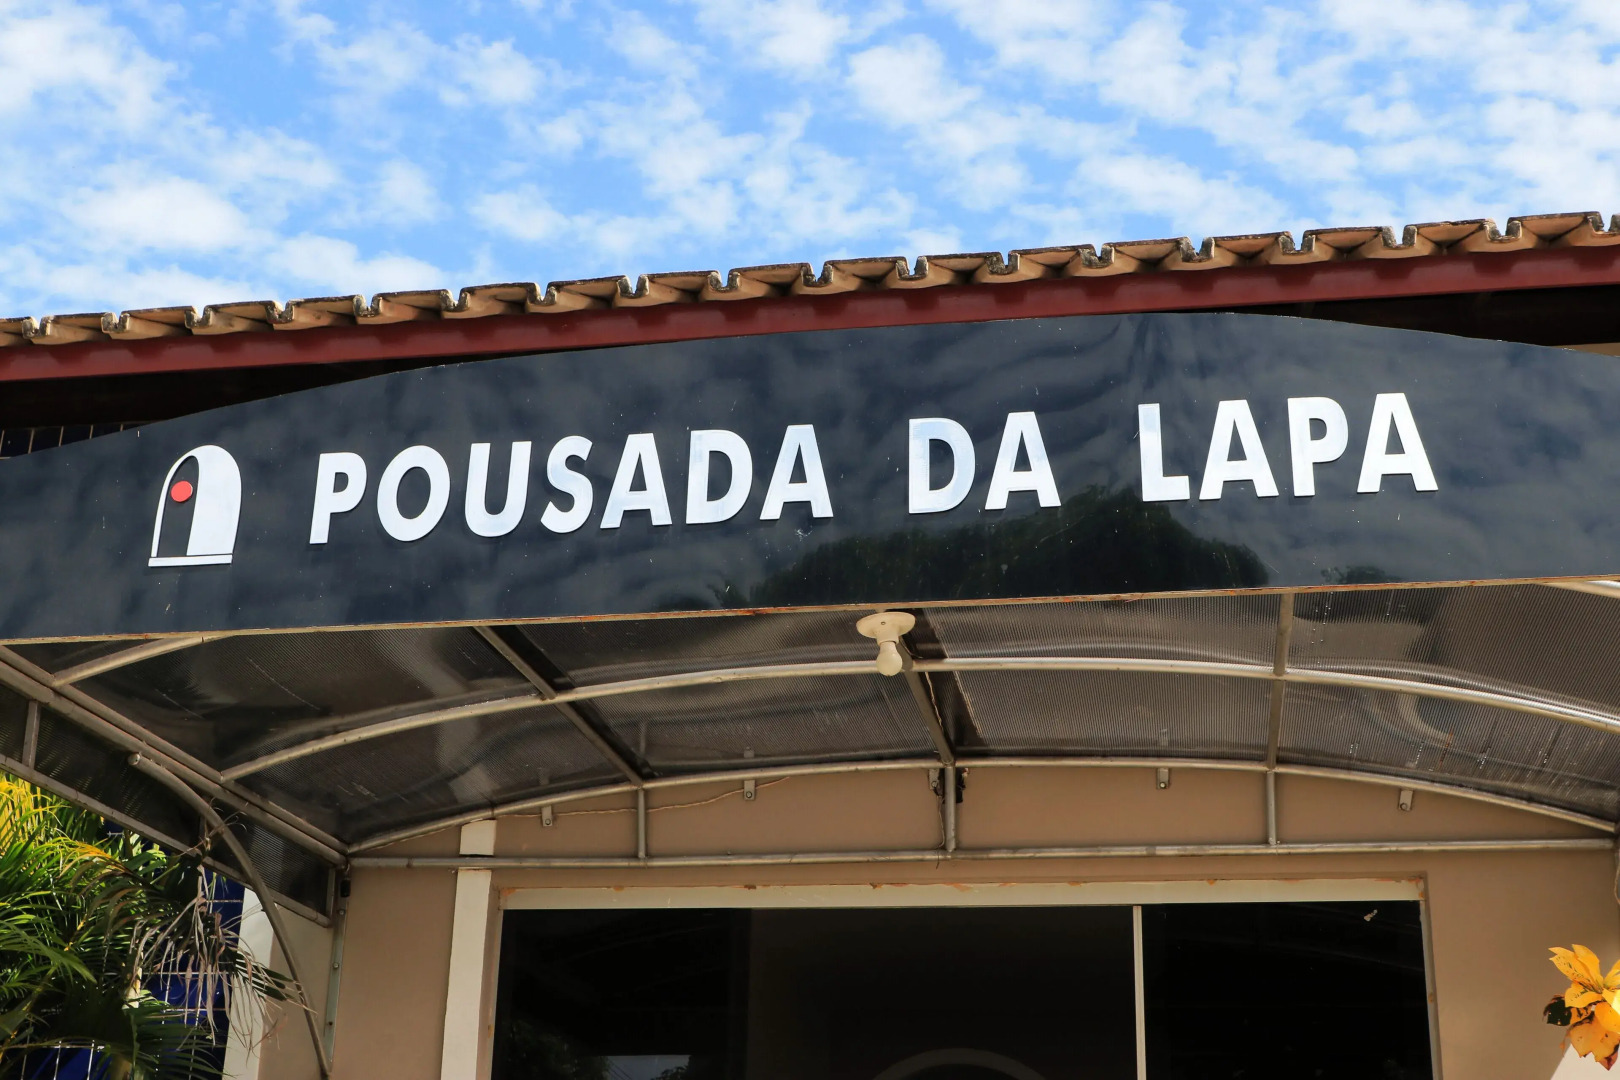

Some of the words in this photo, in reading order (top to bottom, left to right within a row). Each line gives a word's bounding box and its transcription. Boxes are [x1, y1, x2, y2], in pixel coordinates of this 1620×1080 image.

[309, 424, 834, 545] POUSADA
[907, 411, 1062, 515] DA
[1137, 392, 1439, 503] LAPA
